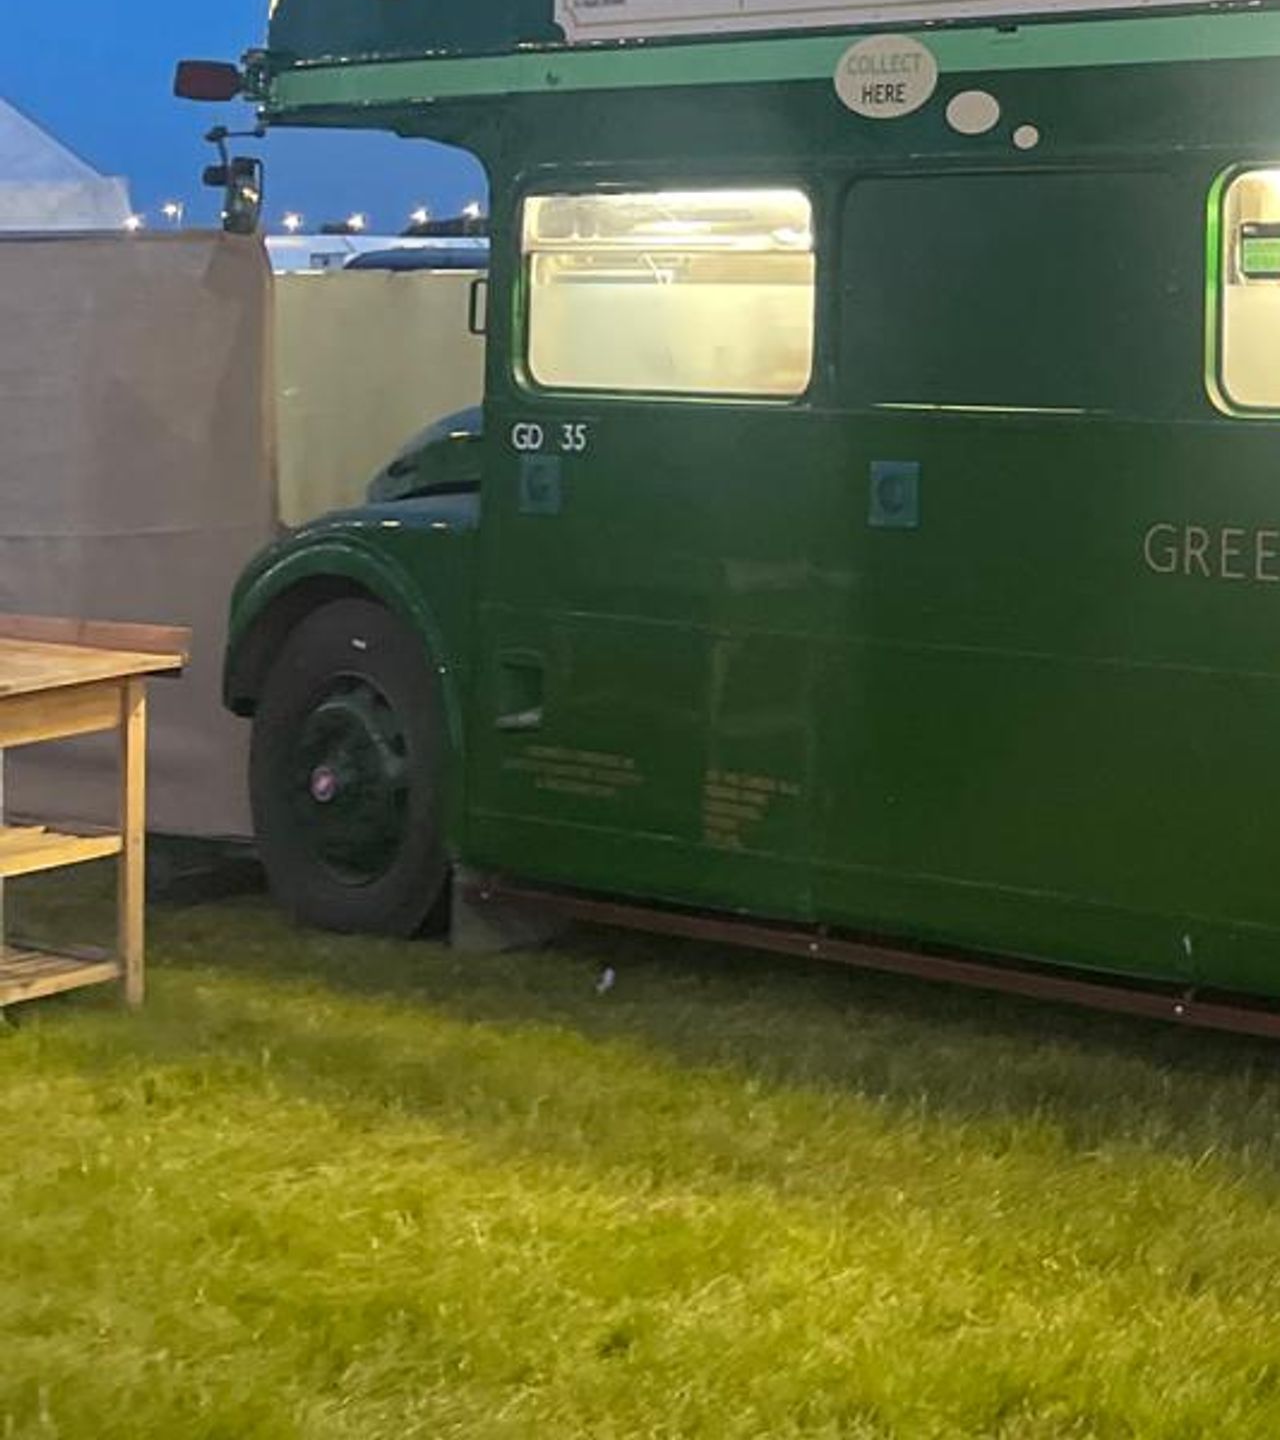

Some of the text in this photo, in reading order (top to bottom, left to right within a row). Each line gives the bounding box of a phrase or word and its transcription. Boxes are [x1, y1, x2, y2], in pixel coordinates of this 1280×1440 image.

[846, 53, 922, 76] COLLECT
[861, 82, 907, 104] HERE
[511, 423, 588, 450] GD 35
